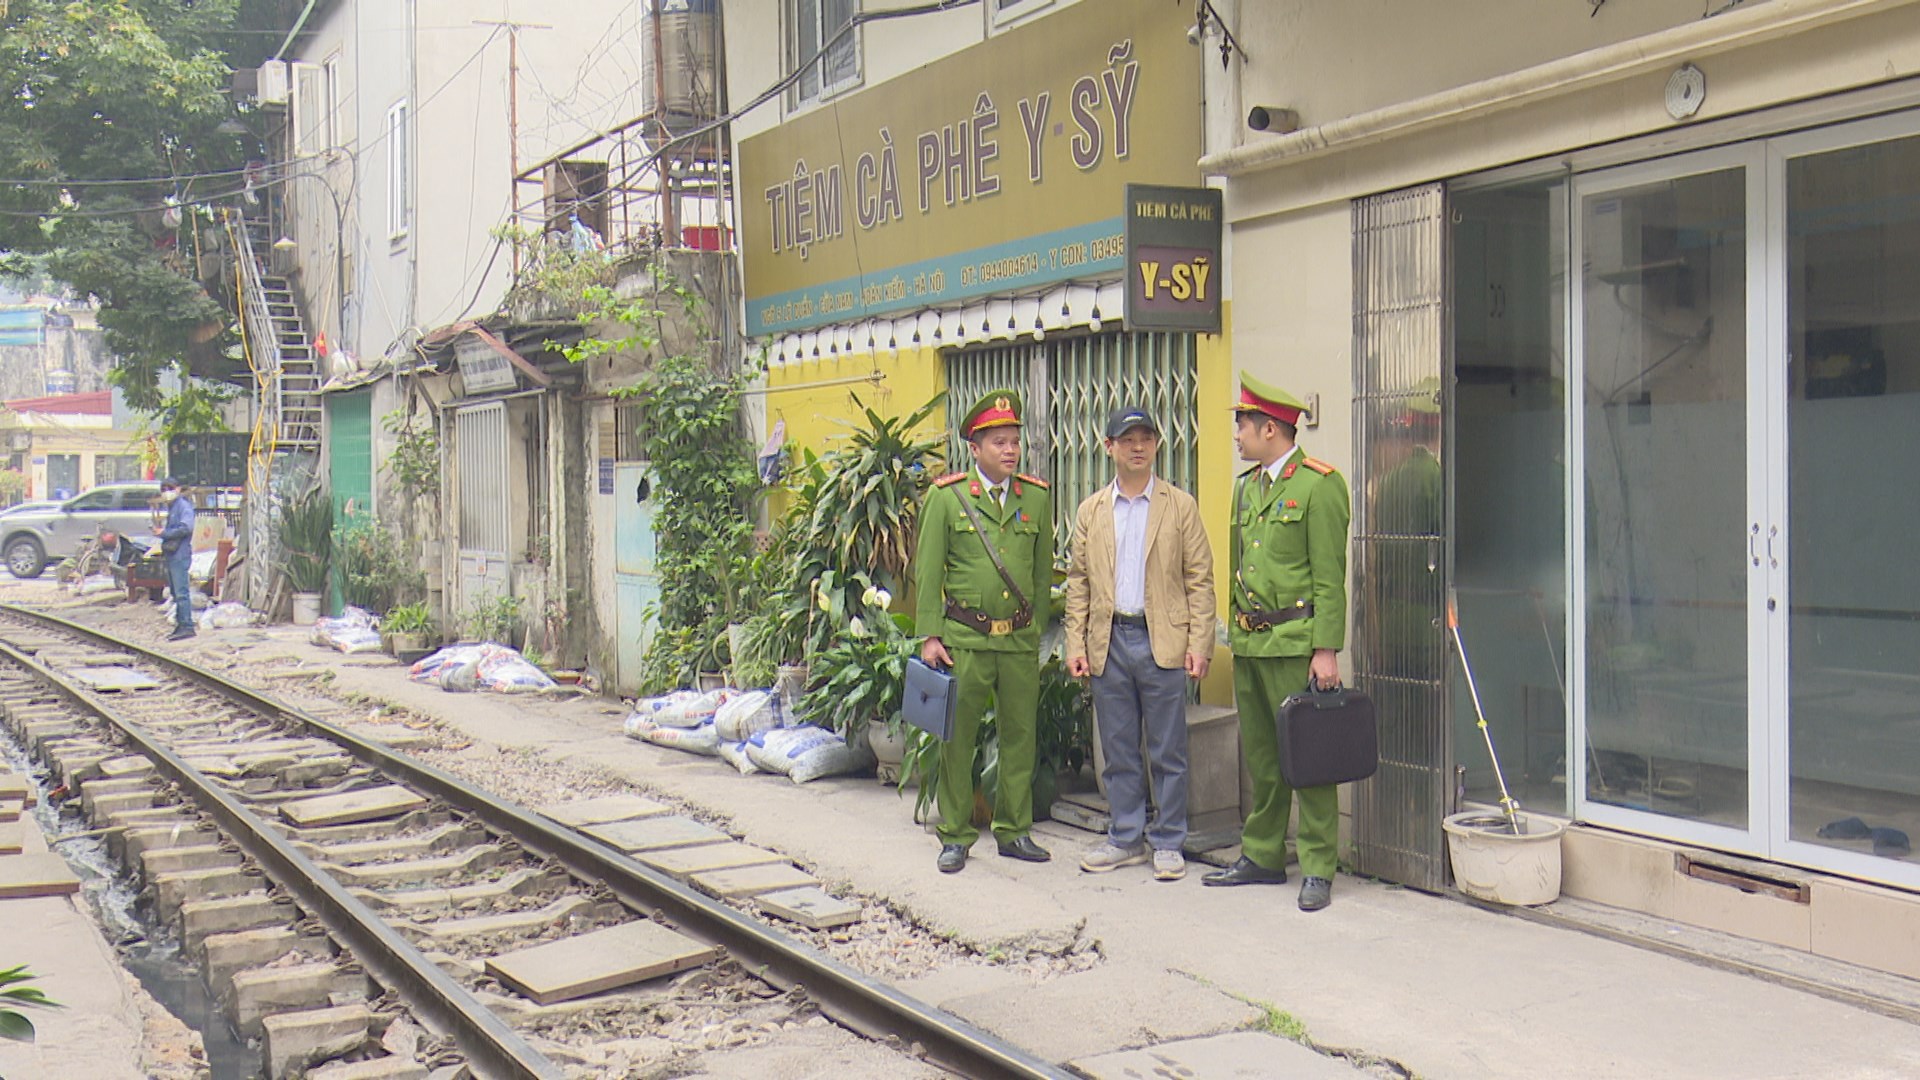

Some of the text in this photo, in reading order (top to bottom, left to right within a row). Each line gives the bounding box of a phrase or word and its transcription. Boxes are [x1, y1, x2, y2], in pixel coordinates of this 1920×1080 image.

[765, 158, 842, 259] TIỆM
[855, 126, 902, 229] CÀ
[917, 90, 1000, 212] PHÊ
[836, 292, 854, 313] NAM
[980, 252, 1039, 284] 0944004614
[1049, 248, 1058, 270] Y
[1140, 256, 1210, 300] Y-SỸ
